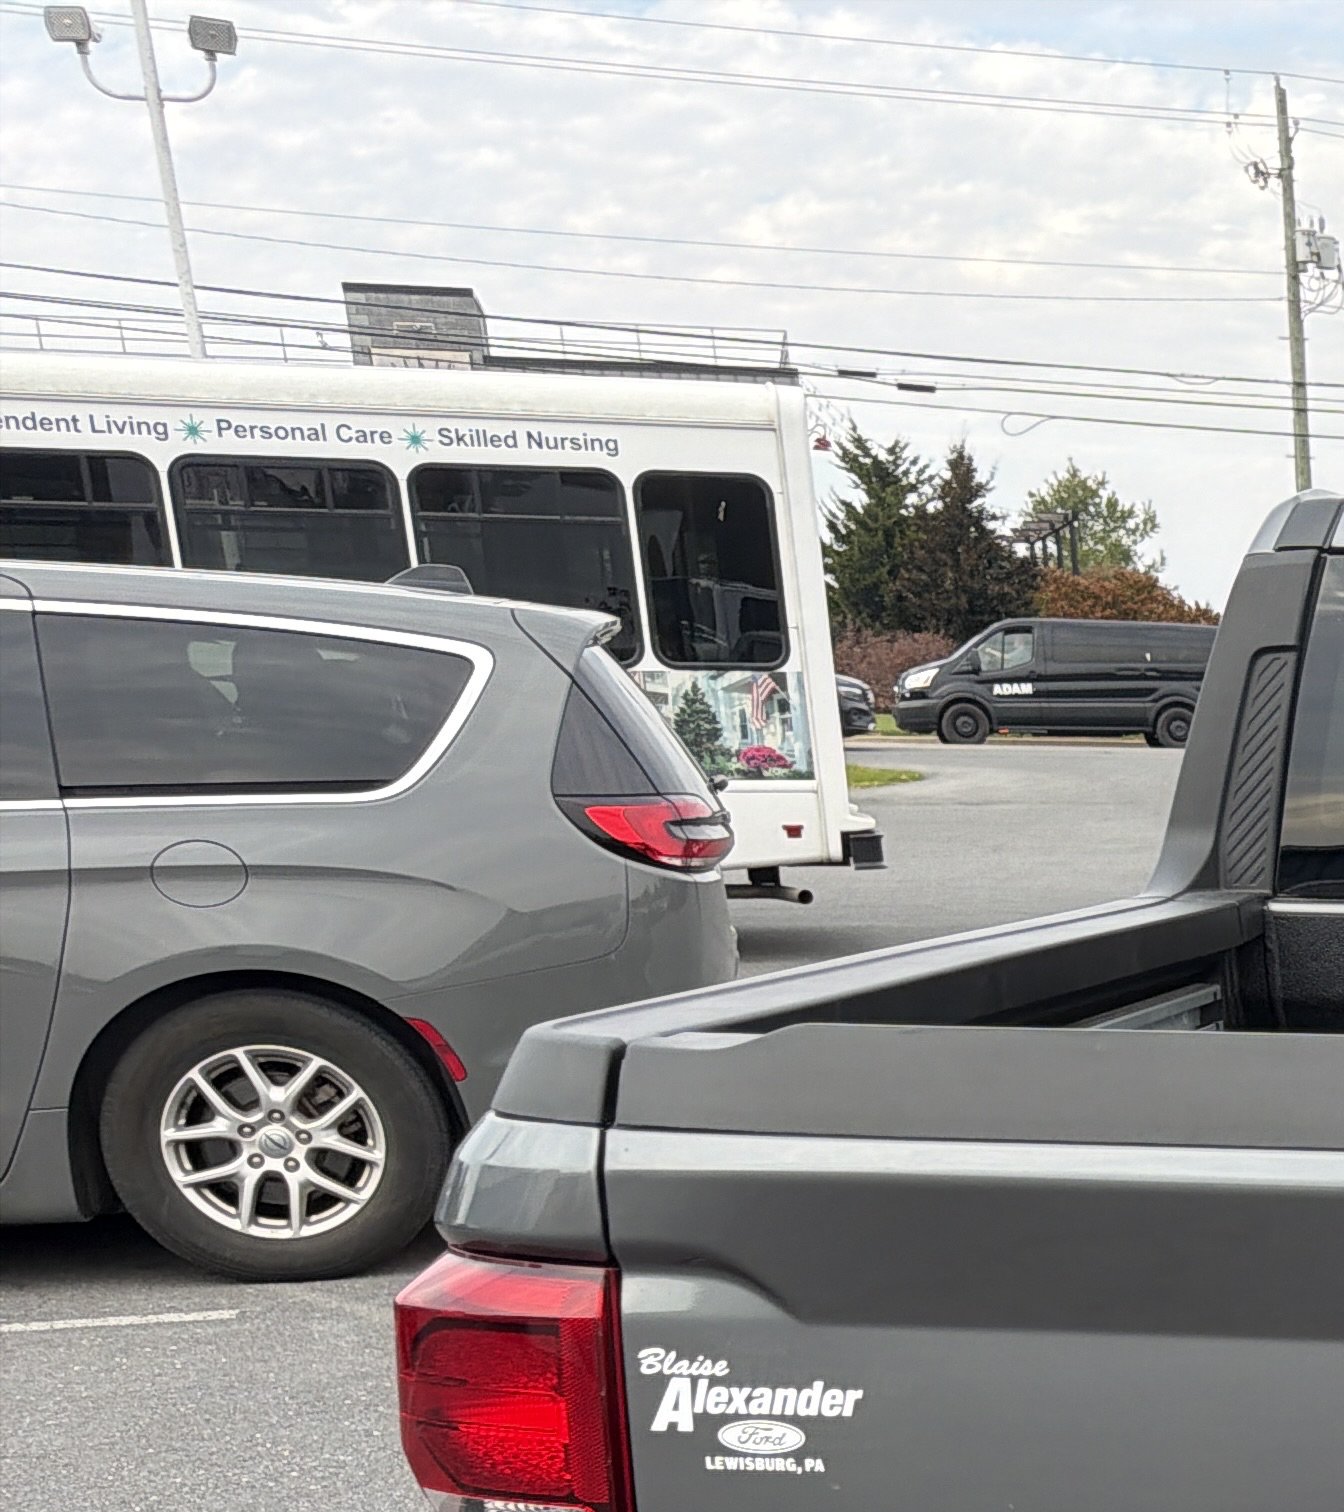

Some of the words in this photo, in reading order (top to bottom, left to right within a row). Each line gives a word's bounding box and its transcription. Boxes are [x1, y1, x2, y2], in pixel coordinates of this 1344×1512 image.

[88, 414, 169, 441] Living
[216, 418, 327, 442] Personal
[335, 423, 393, 445] Care
[437, 427, 518, 449] Skilled
[526, 431, 619, 457] Nursing
[993, 682, 1033, 696] ADAM
[637, 1347, 731, 1377] Blaise
[650, 1376, 864, 1433] Alexander
[737, 1425, 788, 1446] Ford
[704, 1455, 803, 1475] LEWISBURG,
[804, 1458, 826, 1473] PA
